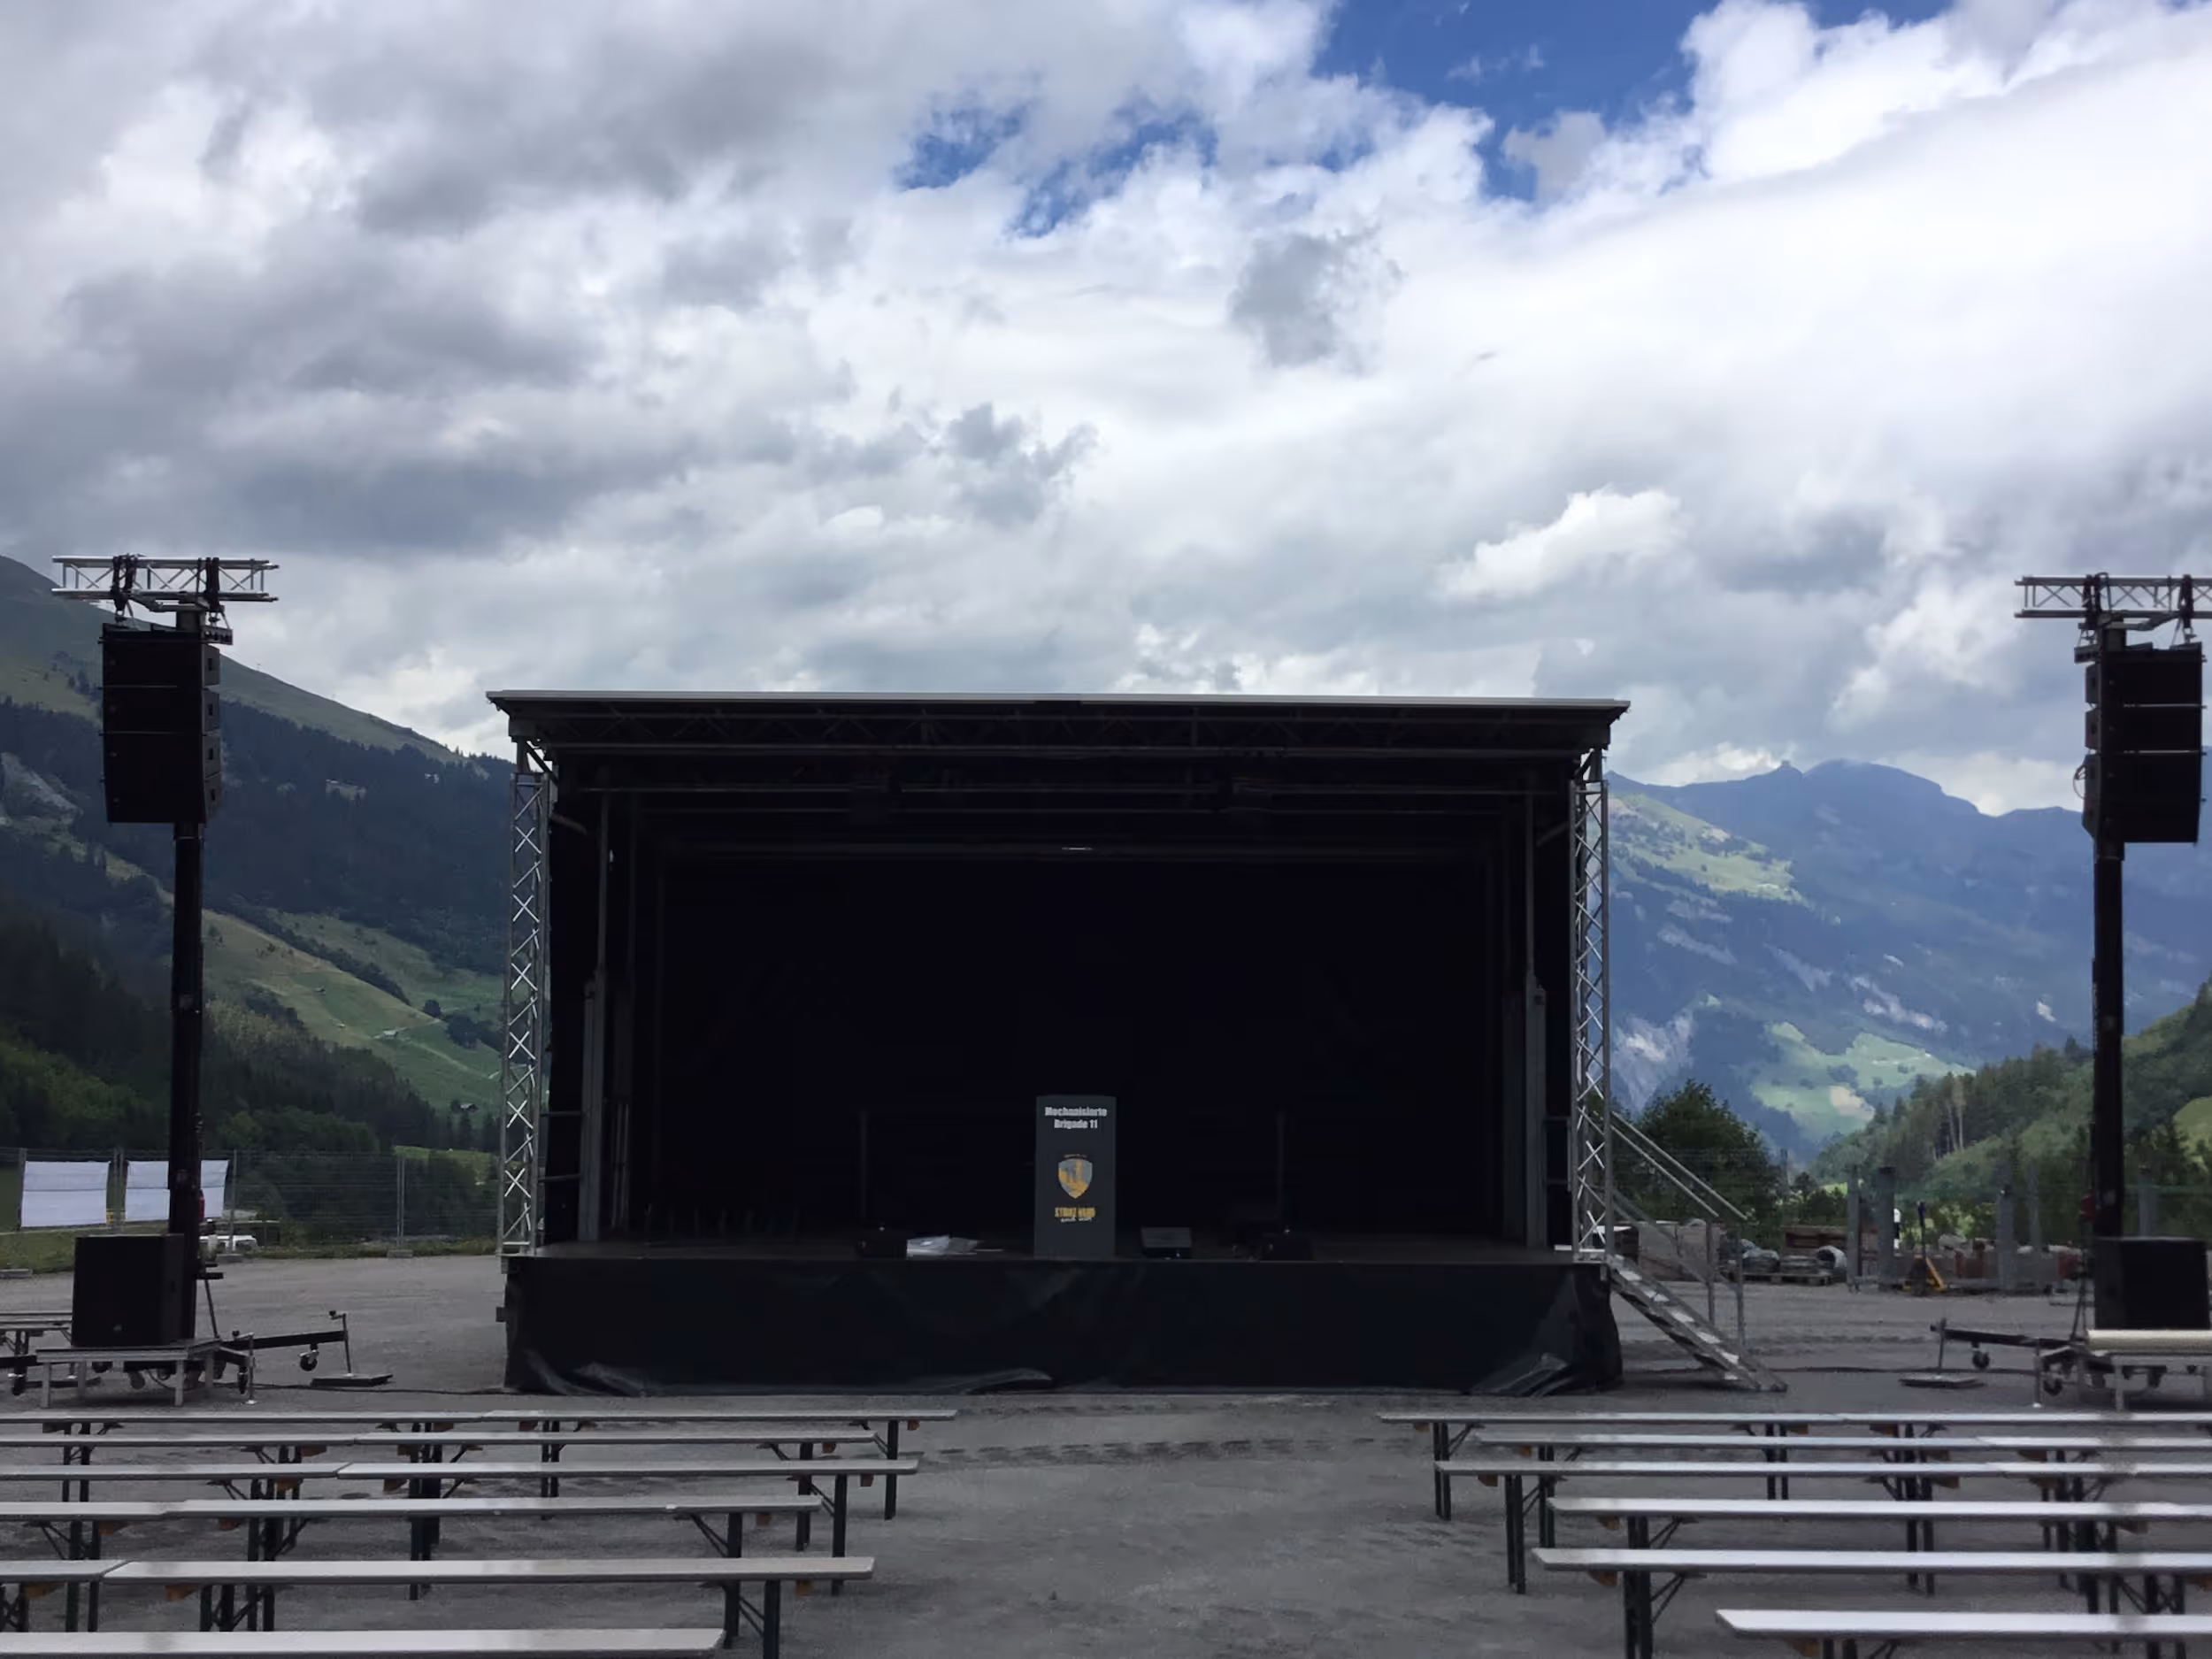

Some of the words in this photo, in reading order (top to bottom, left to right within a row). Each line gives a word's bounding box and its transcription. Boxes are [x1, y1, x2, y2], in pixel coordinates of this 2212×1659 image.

[1045, 1106, 1108, 1118] Mechanisierte
[1054, 1118, 1088, 1129] Brigade
[1089, 1118, 1098, 1129] 11
